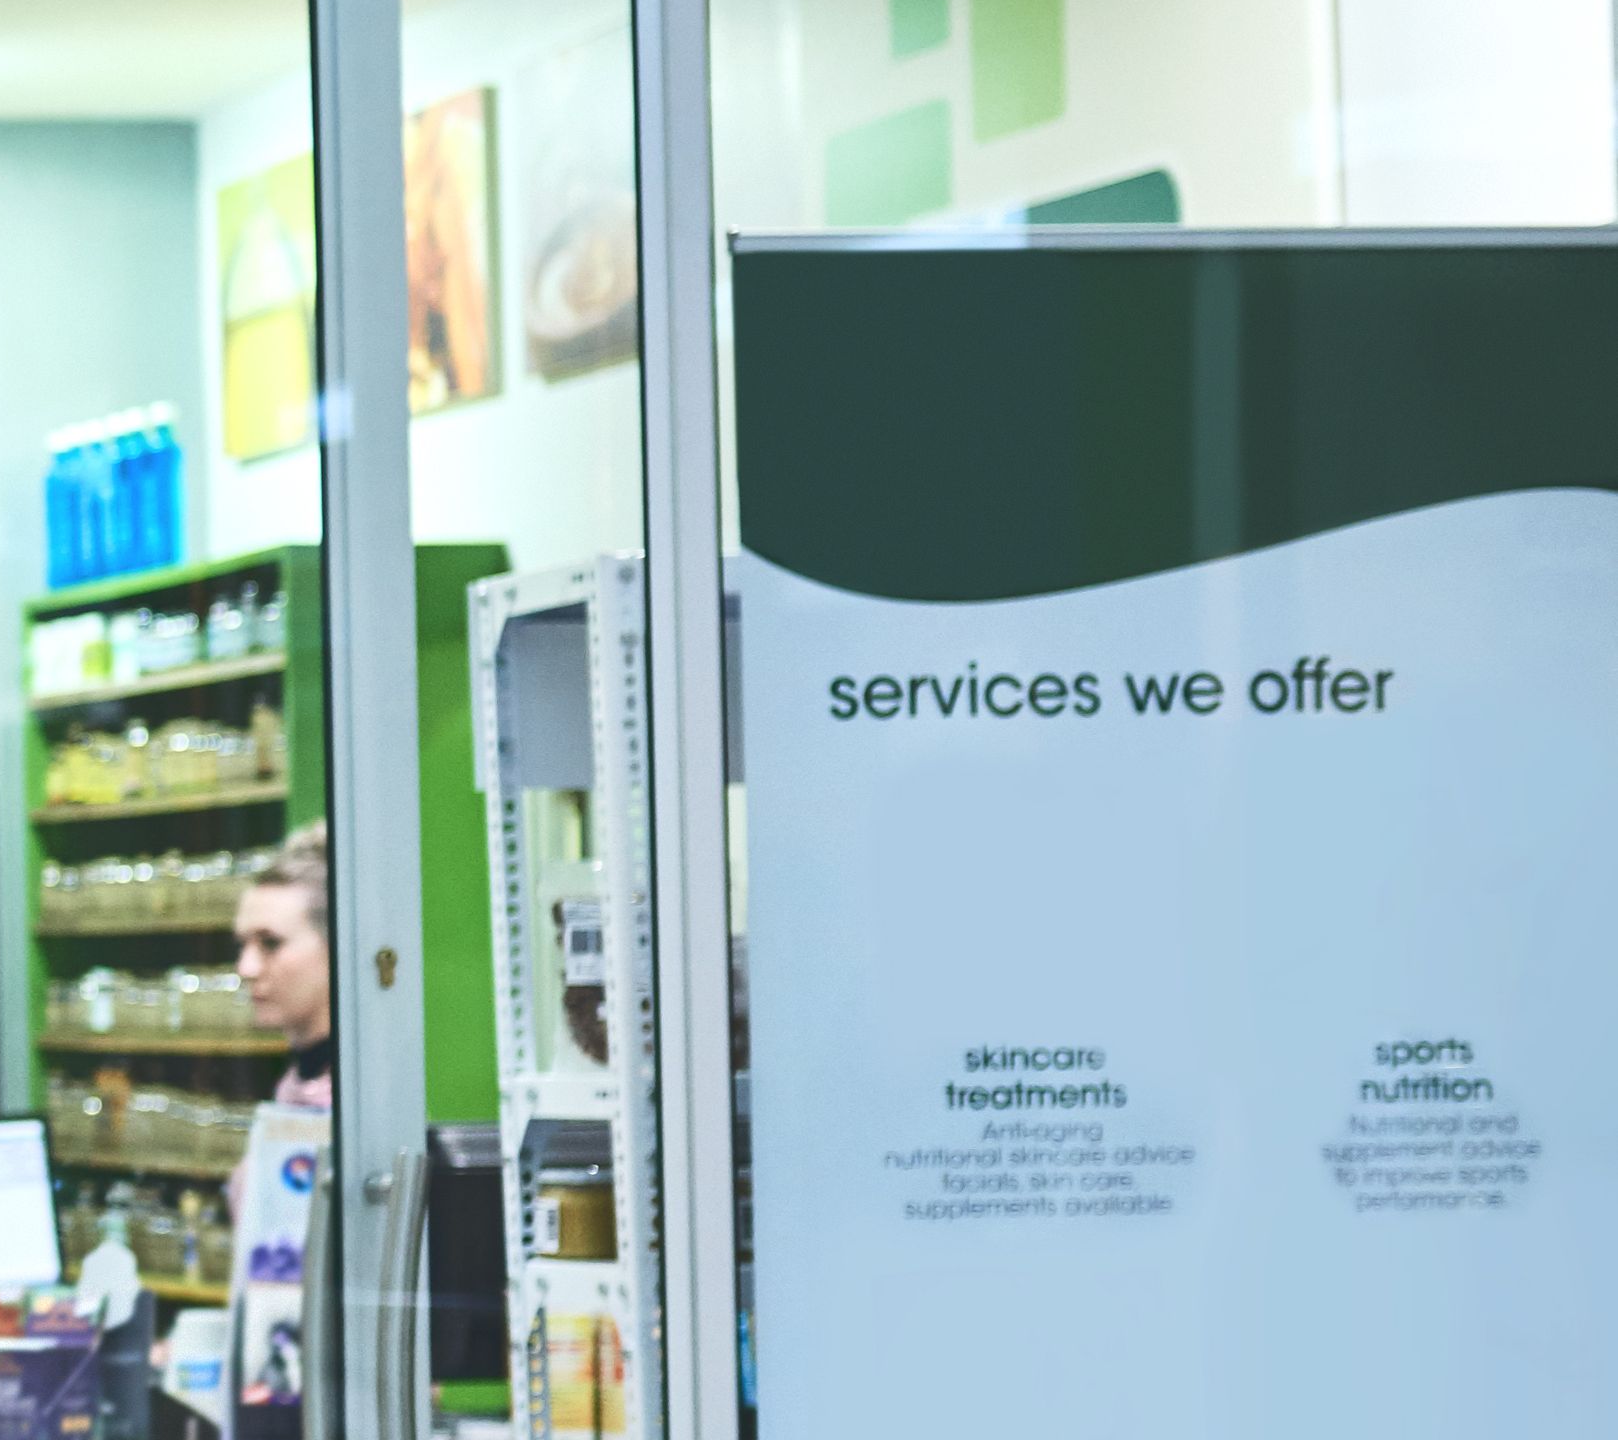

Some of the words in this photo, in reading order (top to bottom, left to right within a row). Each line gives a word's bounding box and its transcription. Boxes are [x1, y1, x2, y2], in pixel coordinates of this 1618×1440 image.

[829, 663, 1101, 721] services
[1124, 672, 1224, 715] we
[1248, 657, 1393, 714] offer
[964, 1044, 1106, 1072] skincare
[1375, 1039, 1474, 1068] sports
[945, 1080, 1128, 1110] treatments
[1361, 1075, 1494, 1103] nutrition
[1114, 1143, 1196, 1165] advice
